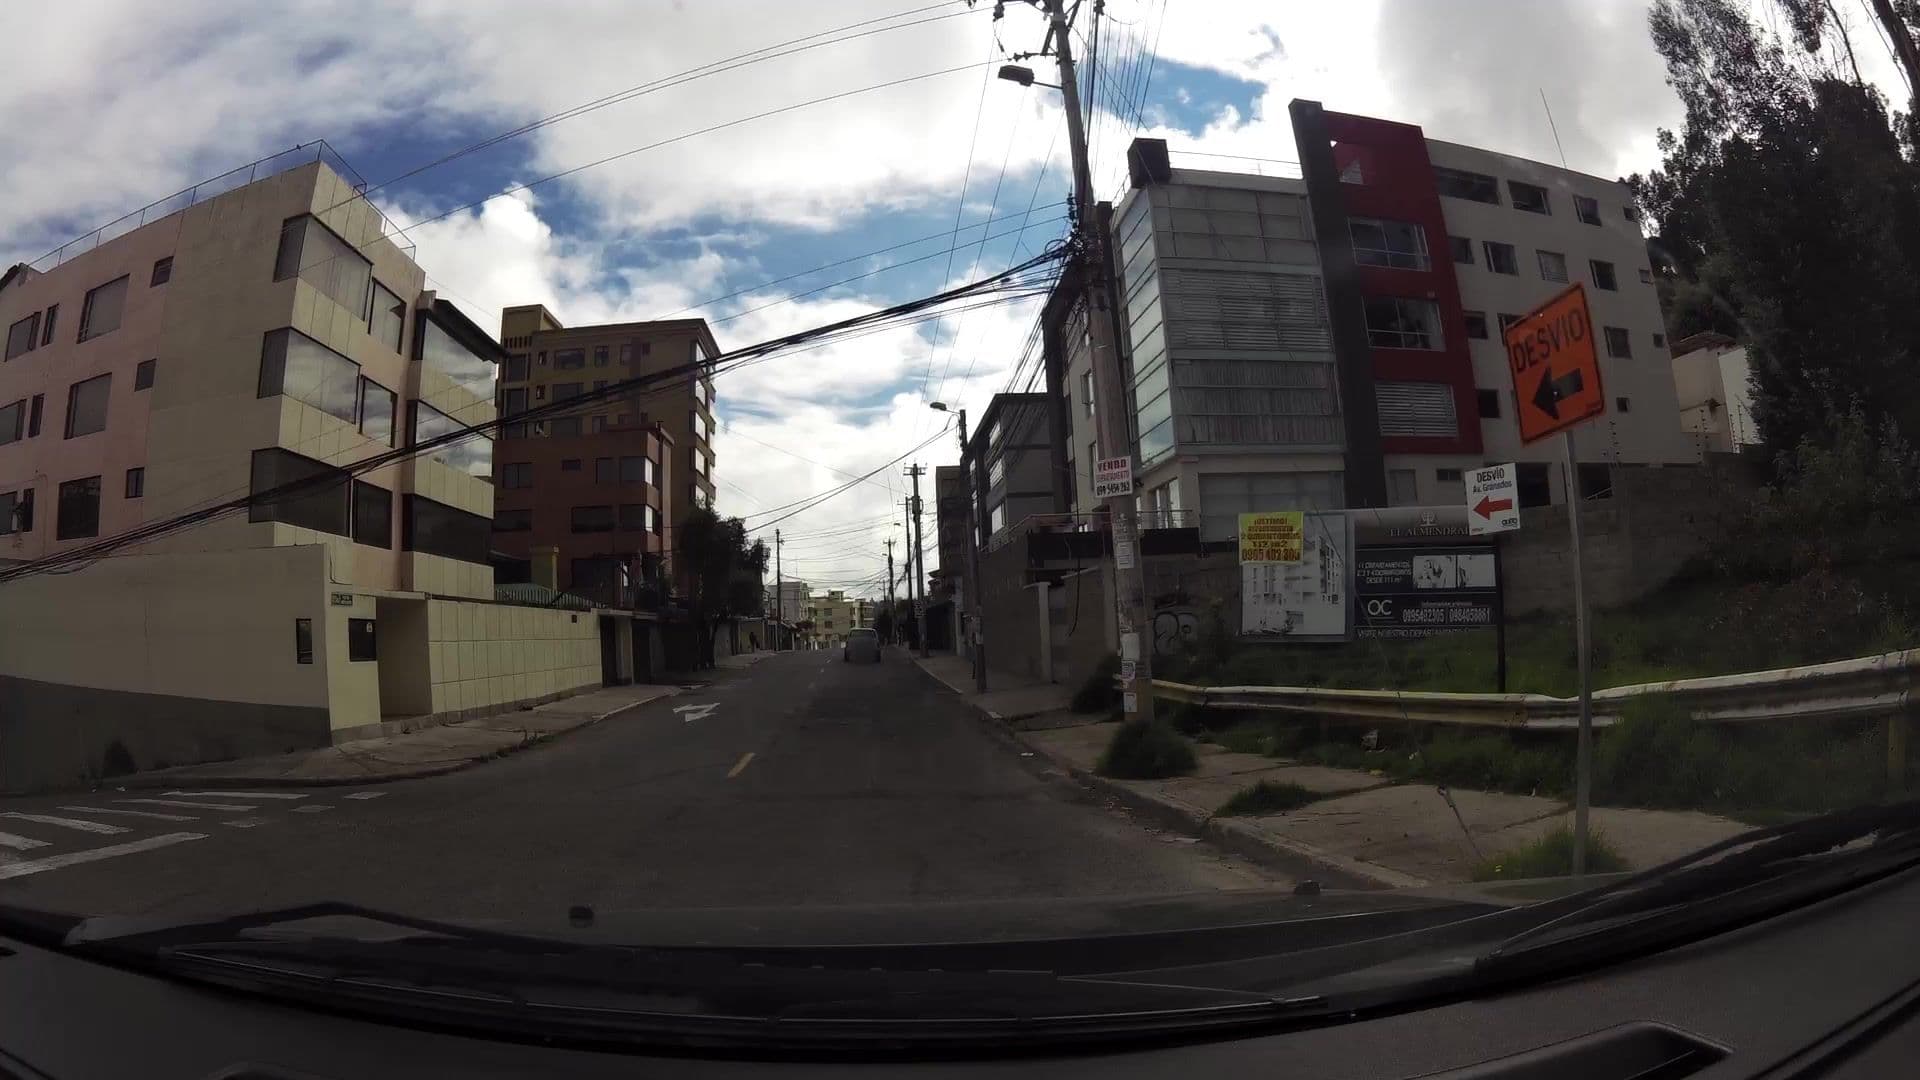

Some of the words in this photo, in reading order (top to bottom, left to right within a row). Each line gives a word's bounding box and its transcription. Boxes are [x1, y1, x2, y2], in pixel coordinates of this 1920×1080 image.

[1511, 308, 1585, 373] DESVIO
[1097, 459, 1127, 472] VENDO
[1483, 480, 1513, 492] Granados
